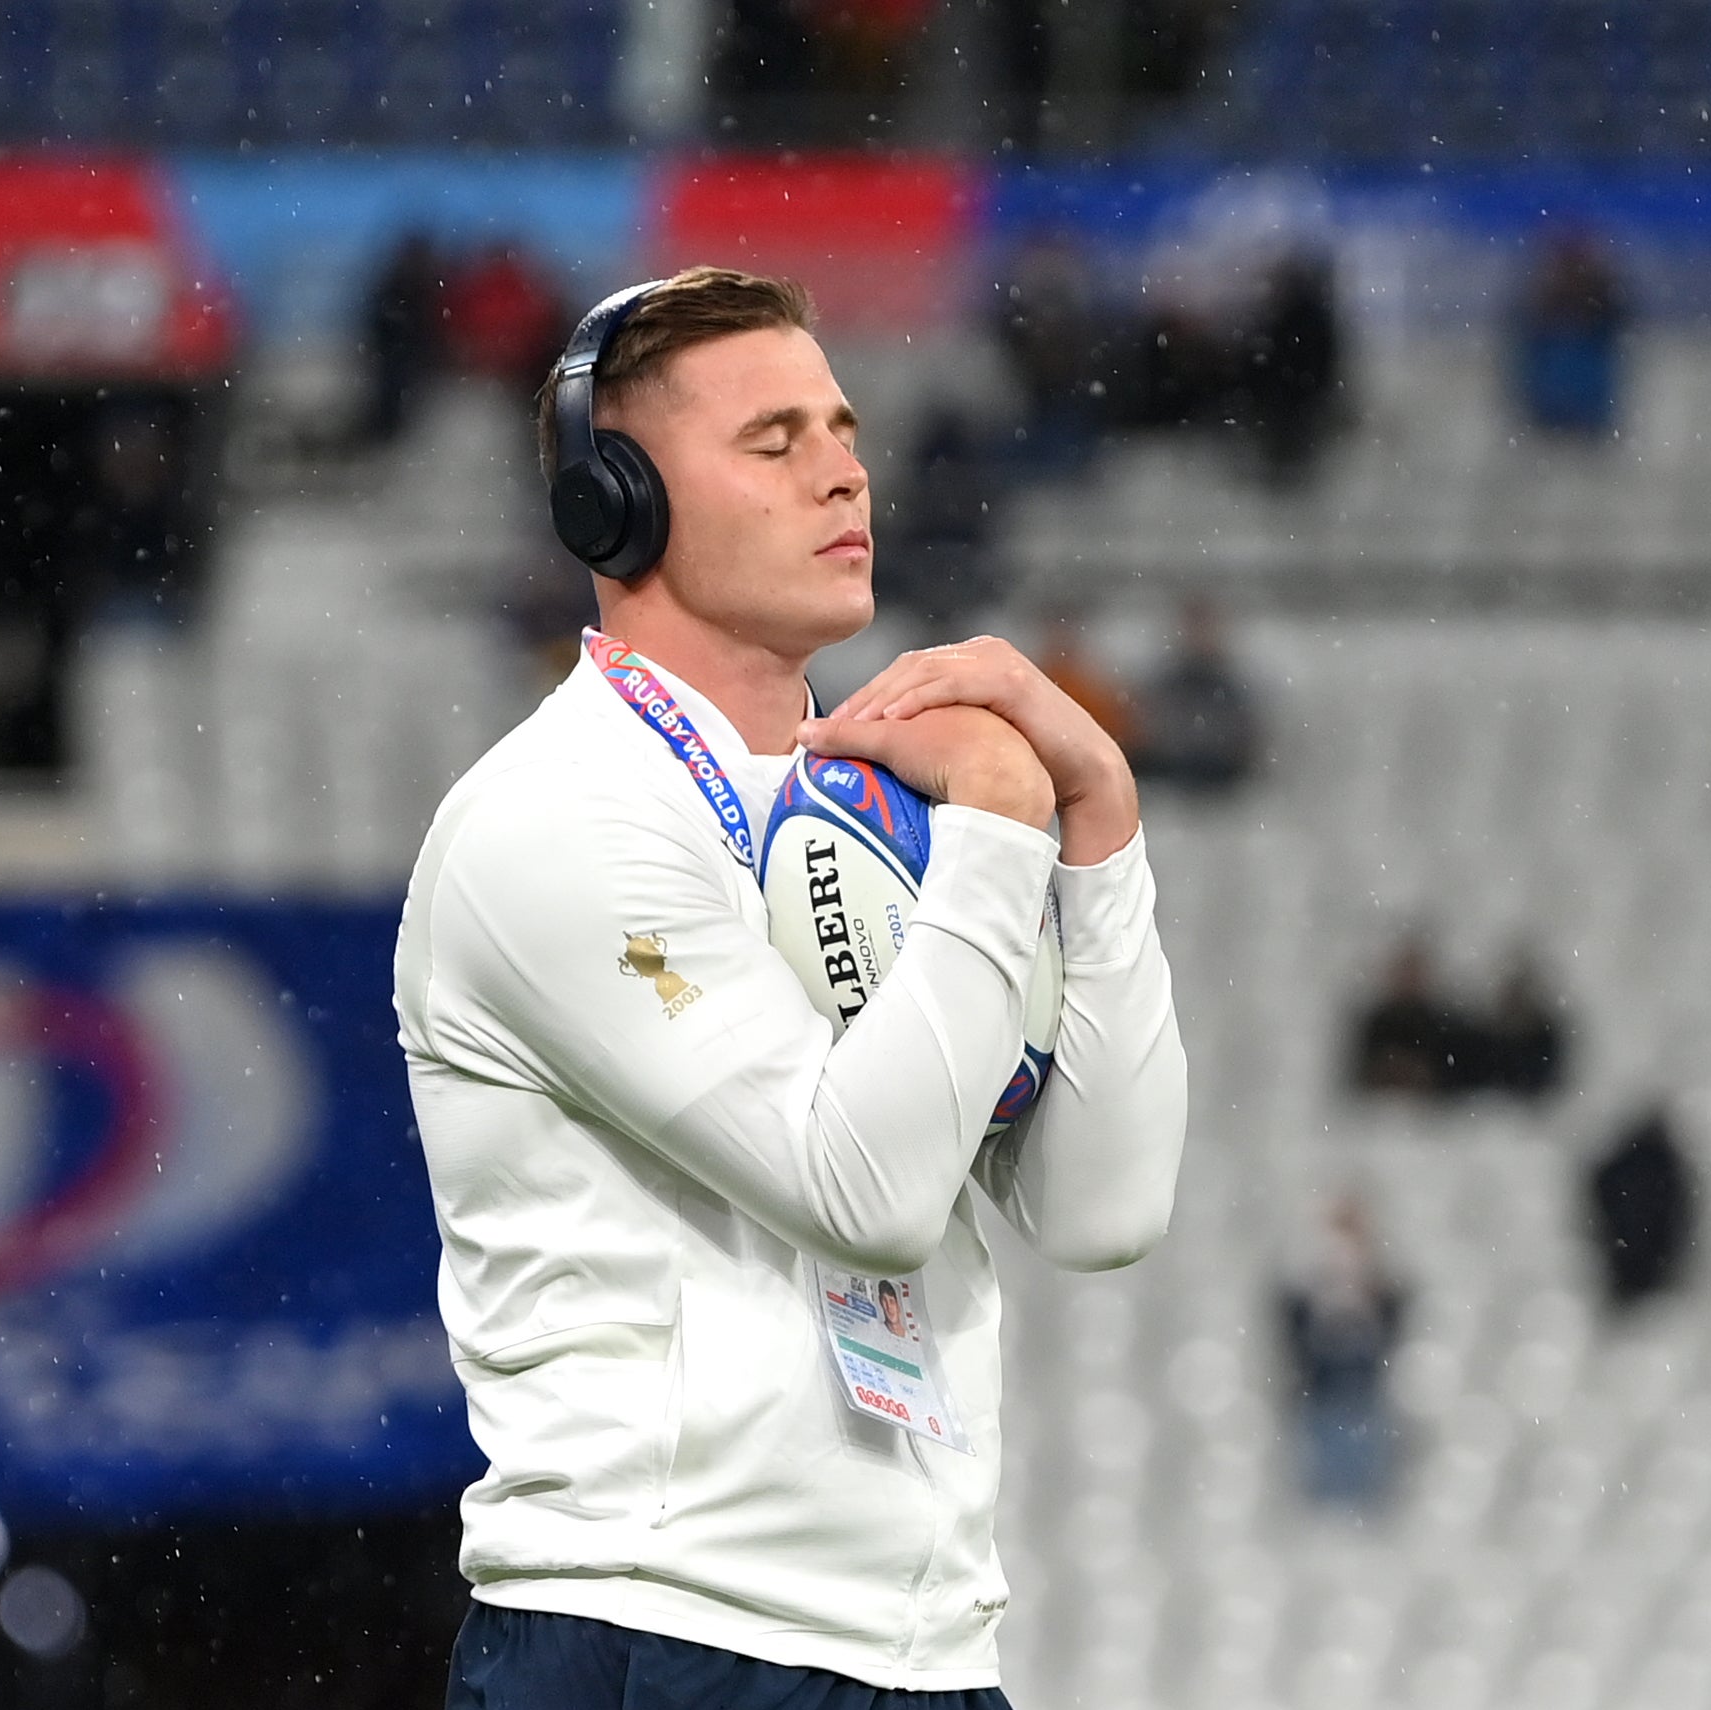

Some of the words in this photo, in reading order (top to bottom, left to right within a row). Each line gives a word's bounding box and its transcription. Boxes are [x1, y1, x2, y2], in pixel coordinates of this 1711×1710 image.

[623, 669, 690, 737] RUGBY
[683, 738, 740, 825] WORLD
[735, 827, 754, 864] CU
[805, 839, 868, 1029] LBERT
[886, 903, 905, 955] C2023
[662, 984, 703, 1020] 2003
